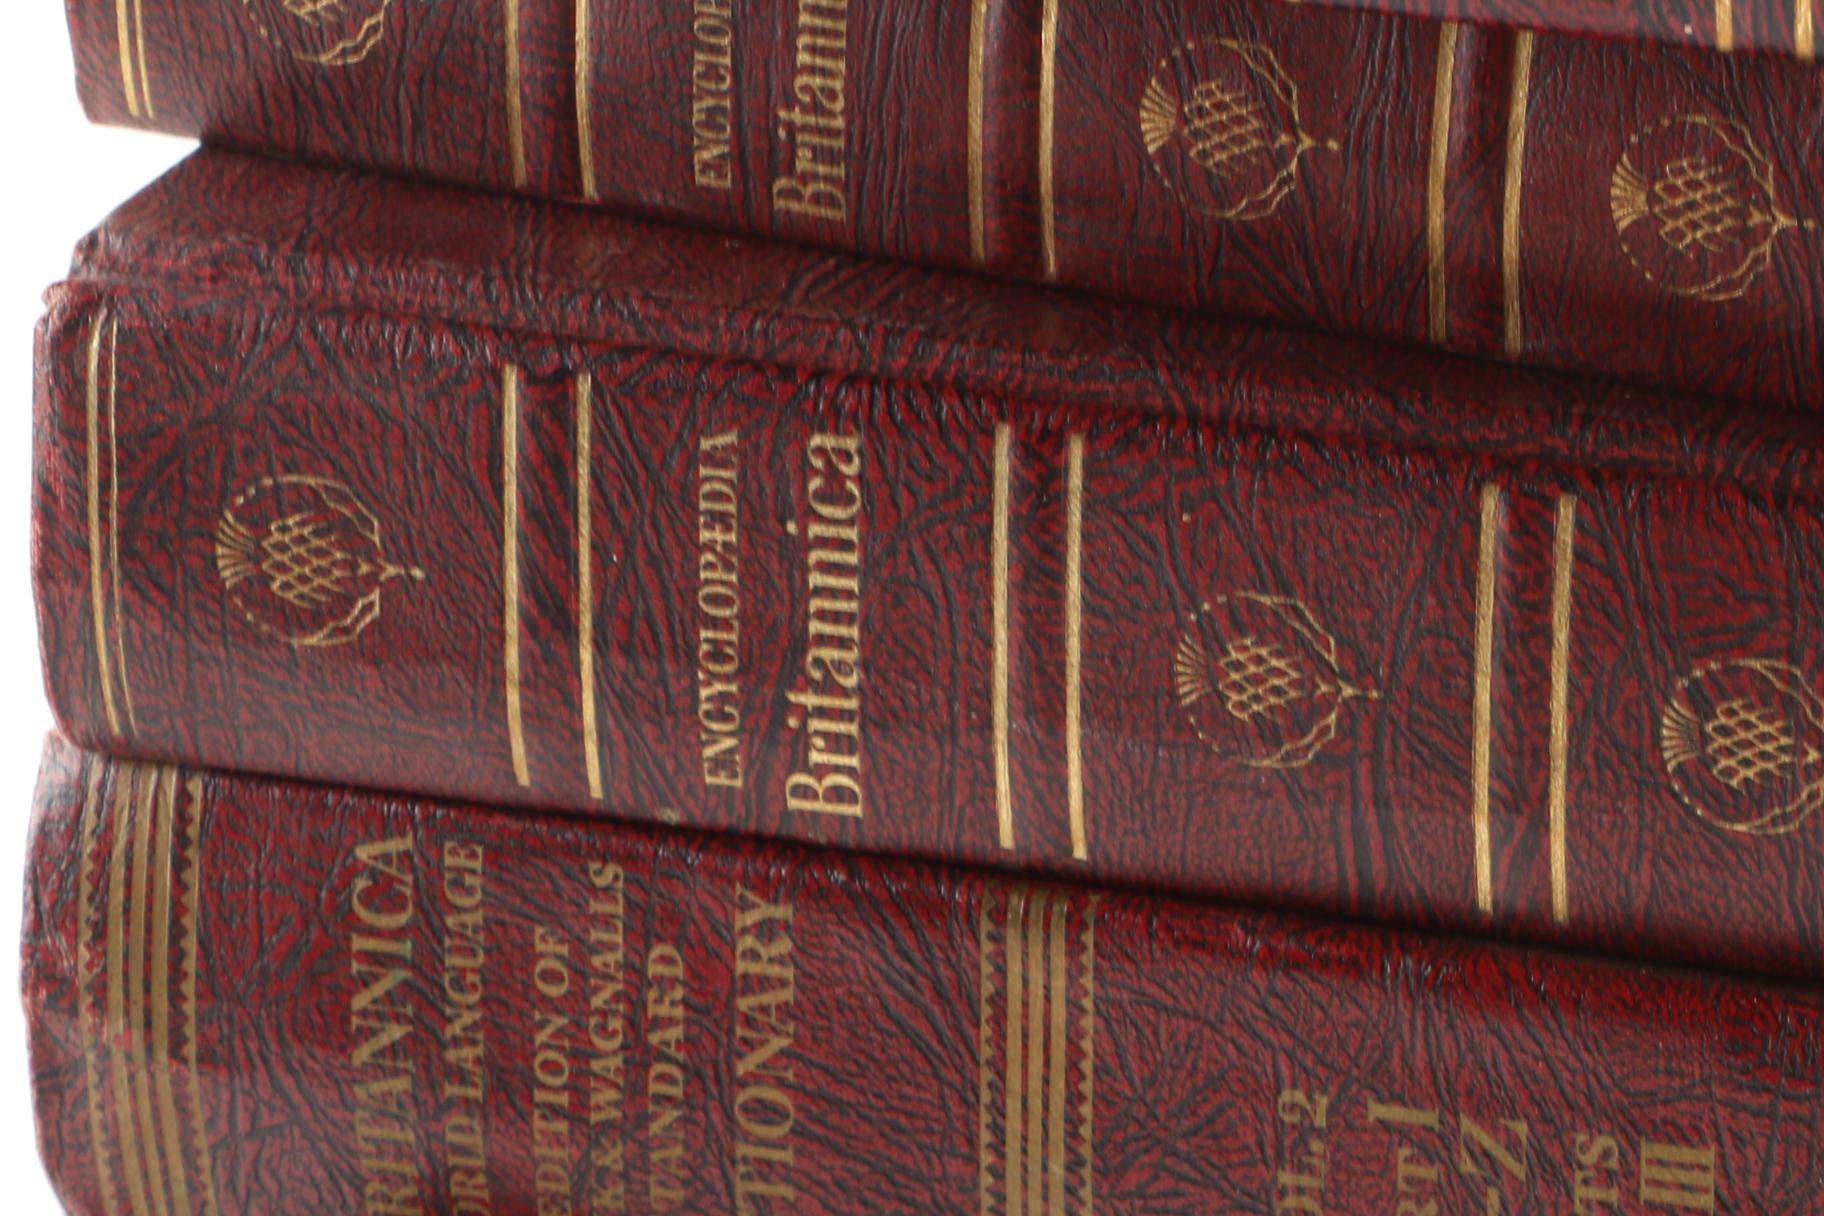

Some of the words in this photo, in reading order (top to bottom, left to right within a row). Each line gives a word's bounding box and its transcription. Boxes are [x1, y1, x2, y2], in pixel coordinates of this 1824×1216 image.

[697, 429, 743, 790] ENCYCLOPÆDIA
[785, 431, 864, 819] Britannica
[444, 840, 485, 1103] LANGUAGE
[533, 926, 569, 998] OF
[589, 861, 625, 1123] WAGNALLS
[593, 1138, 625, 1172] &
[1277, 1088, 1327, 1129] 2
[1367, 1098, 1440, 1133] I
